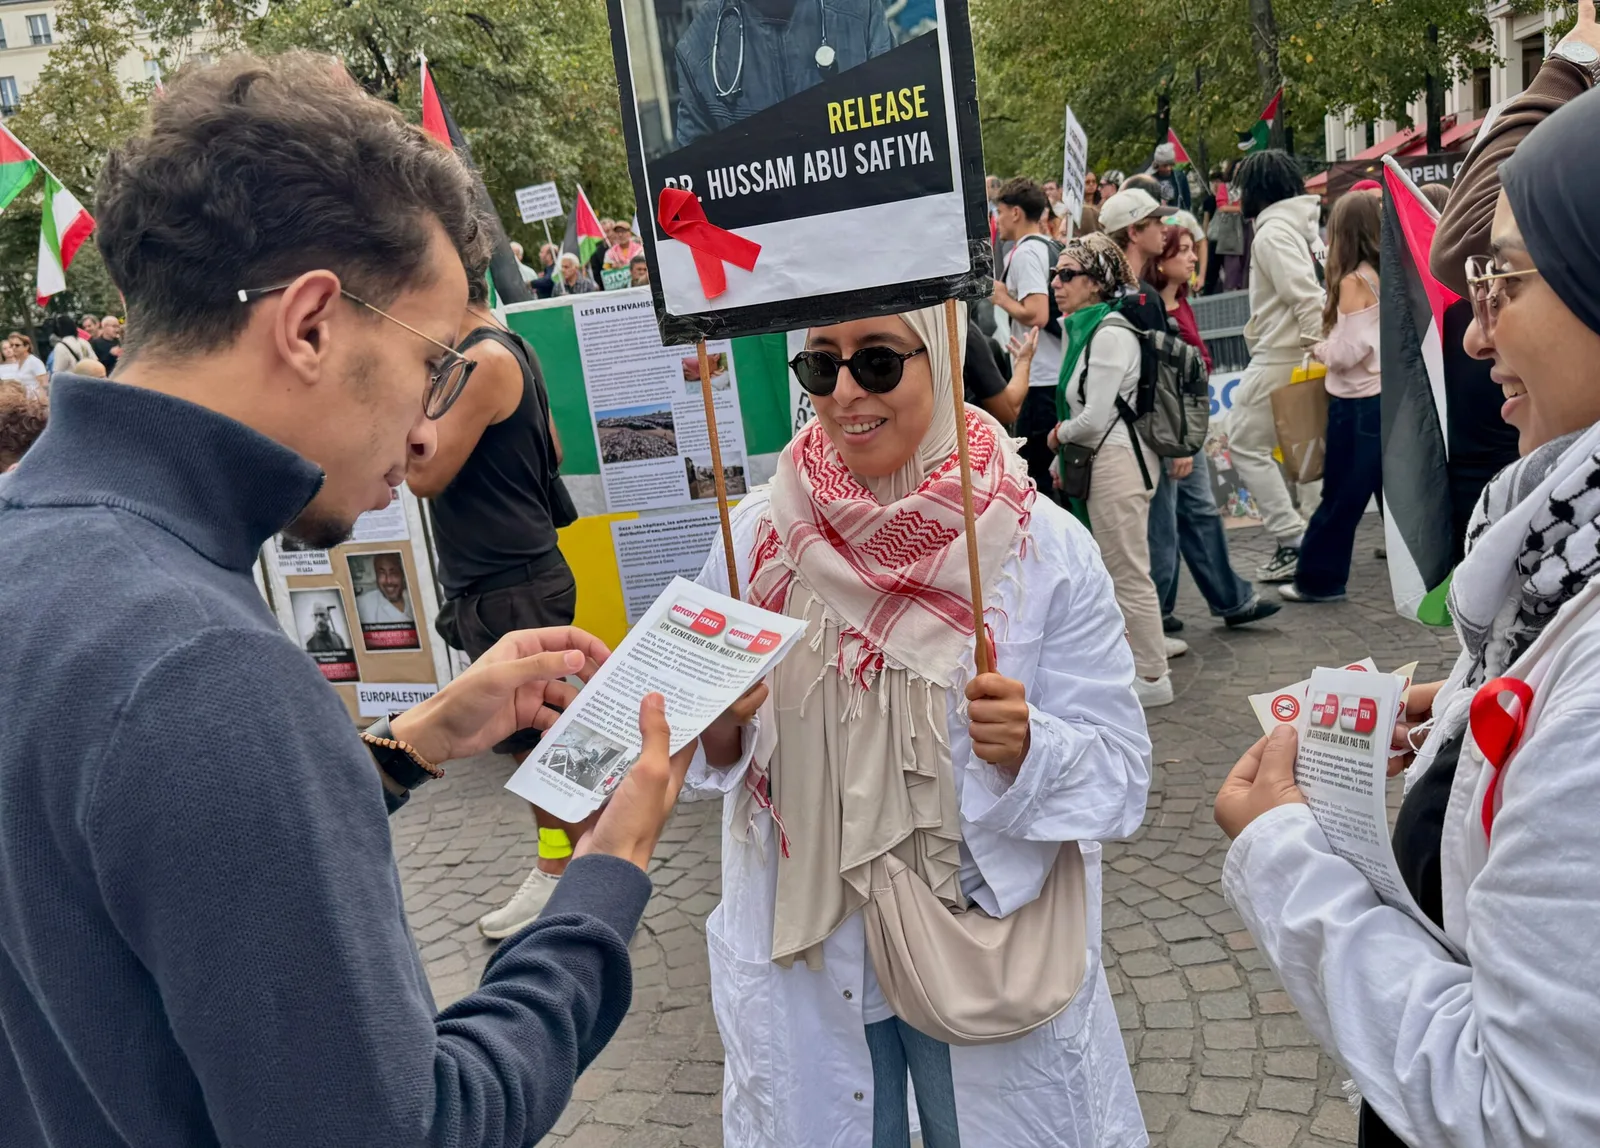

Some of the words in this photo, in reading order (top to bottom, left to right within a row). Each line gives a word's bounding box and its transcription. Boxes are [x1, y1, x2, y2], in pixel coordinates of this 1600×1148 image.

[828, 85, 928, 134] RELEASE
[707, 156, 796, 200] HUSSAM
[804, 146, 848, 184] ABU
[854, 131, 934, 174] SAFIYA
[580, 308, 595, 317] LES
[595, 306, 616, 315] RATS
[672, 604, 698, 620] BOYCOTT
[698, 615, 720, 630] ISRAEL
[660, 622, 672, 632] UN
[670, 626, 706, 648] GENERIQUE
[705, 640, 718, 652] OUI
[717, 644, 737, 659] MAIS
[735, 650, 748, 663] PAS
[728, 626, 754, 642] BOYCOTT
[757, 636, 774, 648] TEVA
[1360, 708, 1370, 720] TEVA
[1330, 732, 1338, 744] OUI
[1339, 734, 1350, 746] MAIS
[1350, 736, 1360, 748] PAS
[1360, 737, 1370, 750] TEVA
